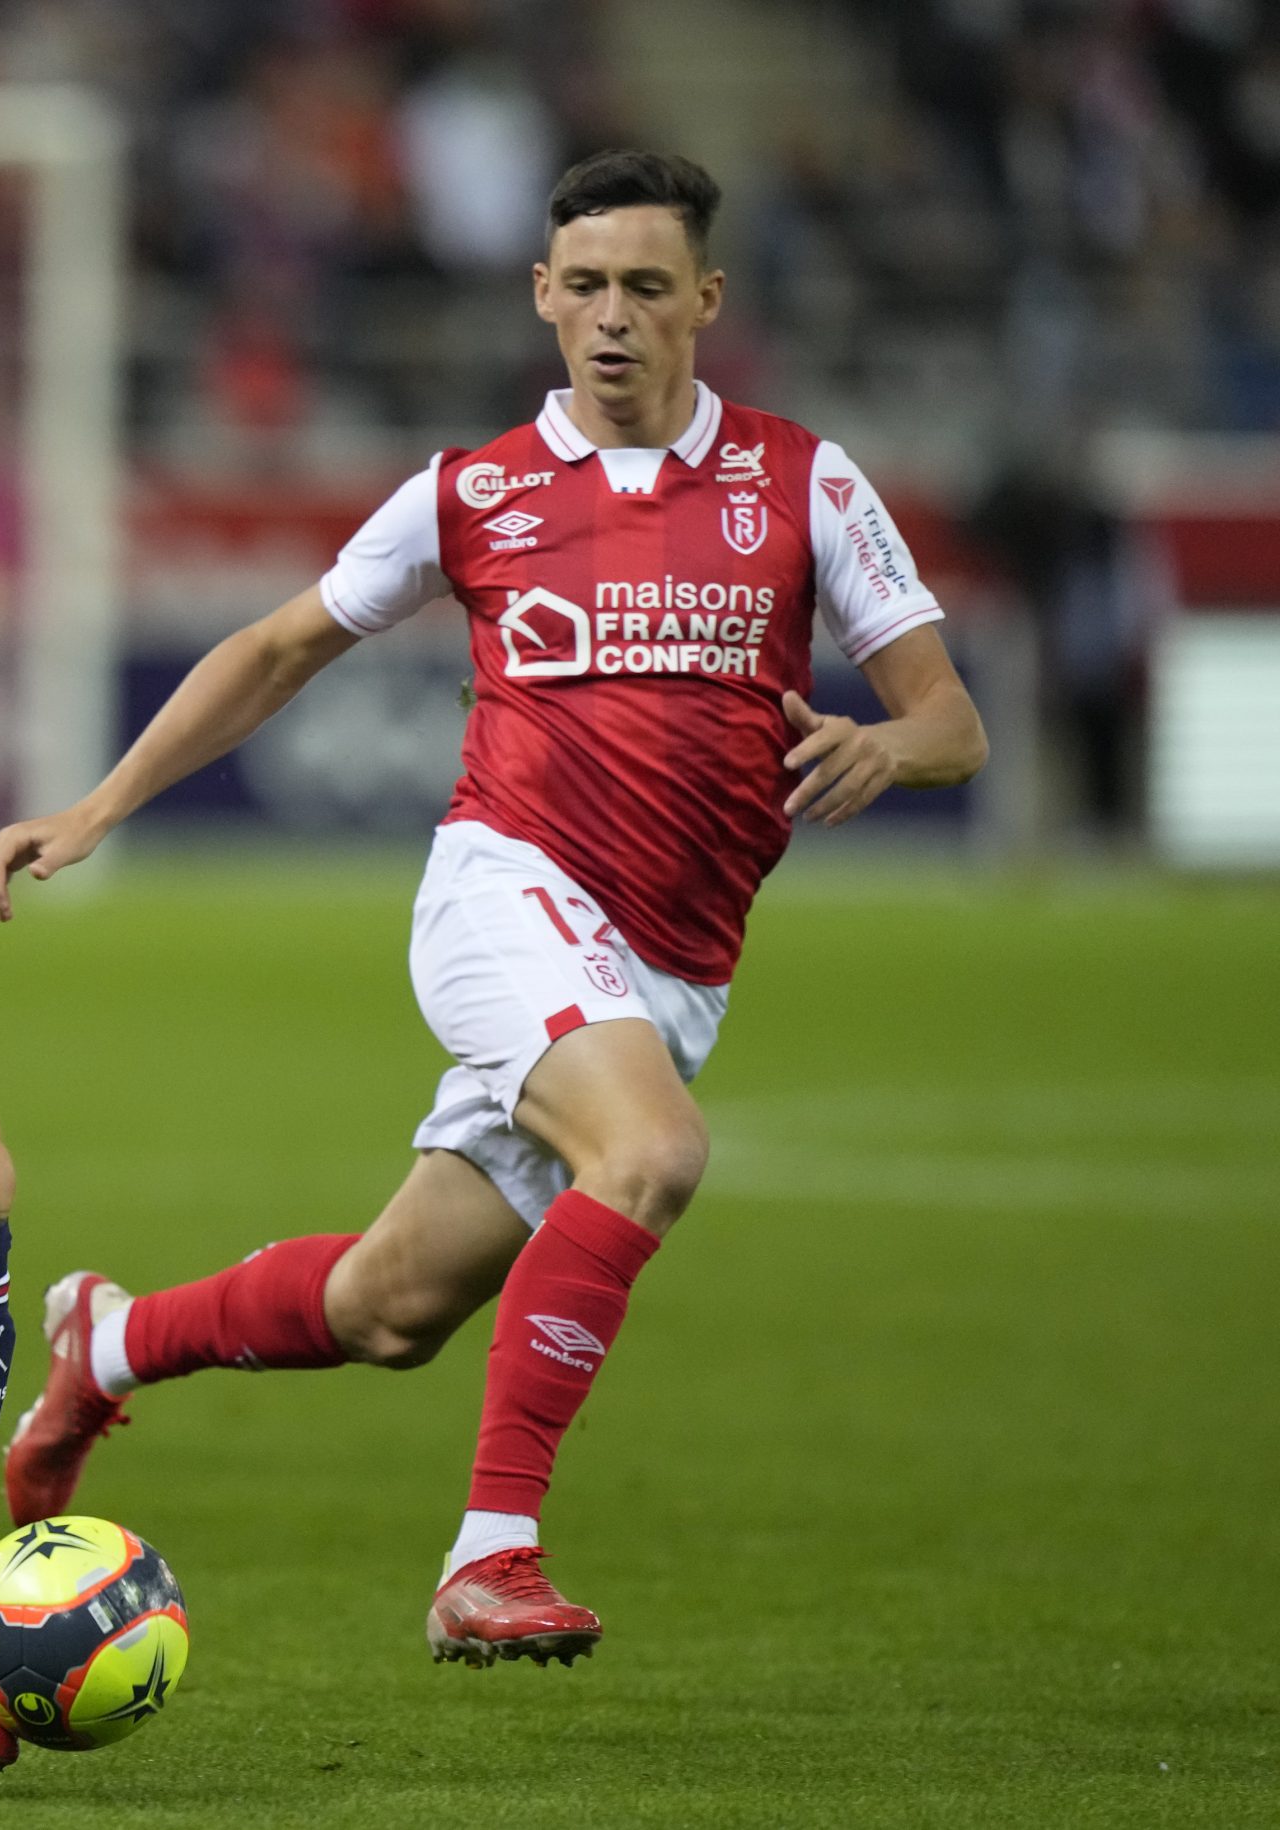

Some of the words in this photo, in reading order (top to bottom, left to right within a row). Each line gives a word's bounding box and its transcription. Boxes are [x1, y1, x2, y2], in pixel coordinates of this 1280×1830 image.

[456, 462, 555, 509] CAILLOT
[489, 536, 538, 551] umbro
[846, 520, 891, 600] intérim
[863, 503, 908, 594] Triangle
[596, 574, 775, 615] maisons
[596, 612, 769, 644] FRANCE
[596, 644, 760, 677] CONFORT
[530, 1338, 593, 1372] umbro
